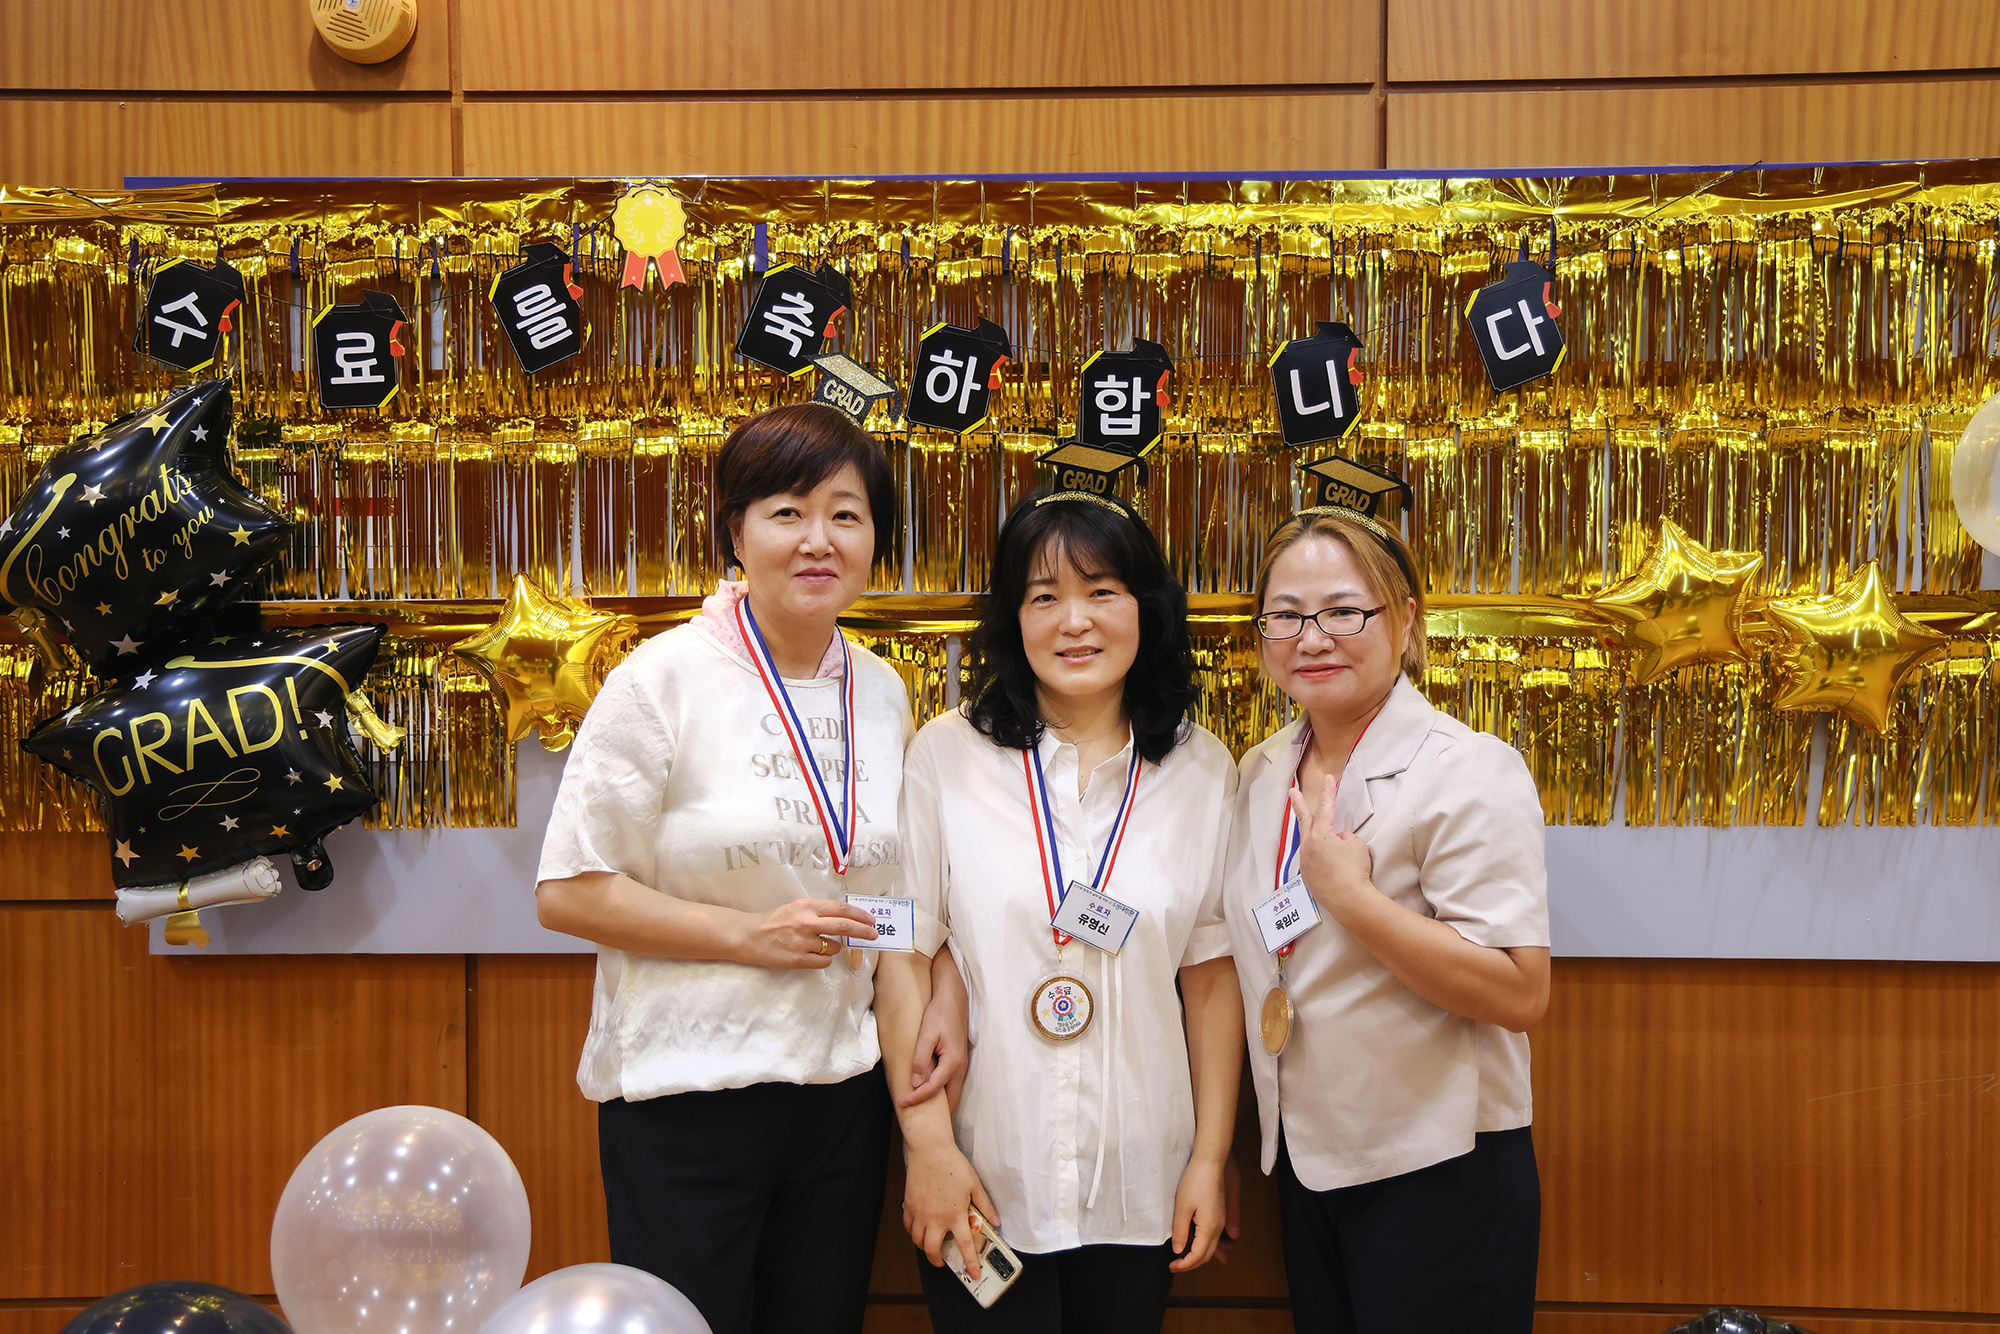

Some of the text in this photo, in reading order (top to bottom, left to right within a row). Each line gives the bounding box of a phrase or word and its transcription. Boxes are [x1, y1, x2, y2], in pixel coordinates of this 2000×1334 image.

[823, 378, 866, 416] GRAD
[1062, 469, 1108, 494] GRAD
[1325, 481, 1371, 512] GRAD
[25, 462, 194, 606] Congrats
[142, 504, 215, 572] to you
[93, 676, 310, 797] GRAD!
[760, 713, 845, 742] CEDI
[773, 796, 872, 825] PRA
[723, 842, 761, 871] IN
[769, 841, 804, 867] TE
[869, 907, 892, 917] 수료자
[1088, 901, 1112, 917] 수료자
[872, 922, 897, 937] 경순
[1077, 913, 1111, 936] 유영신
